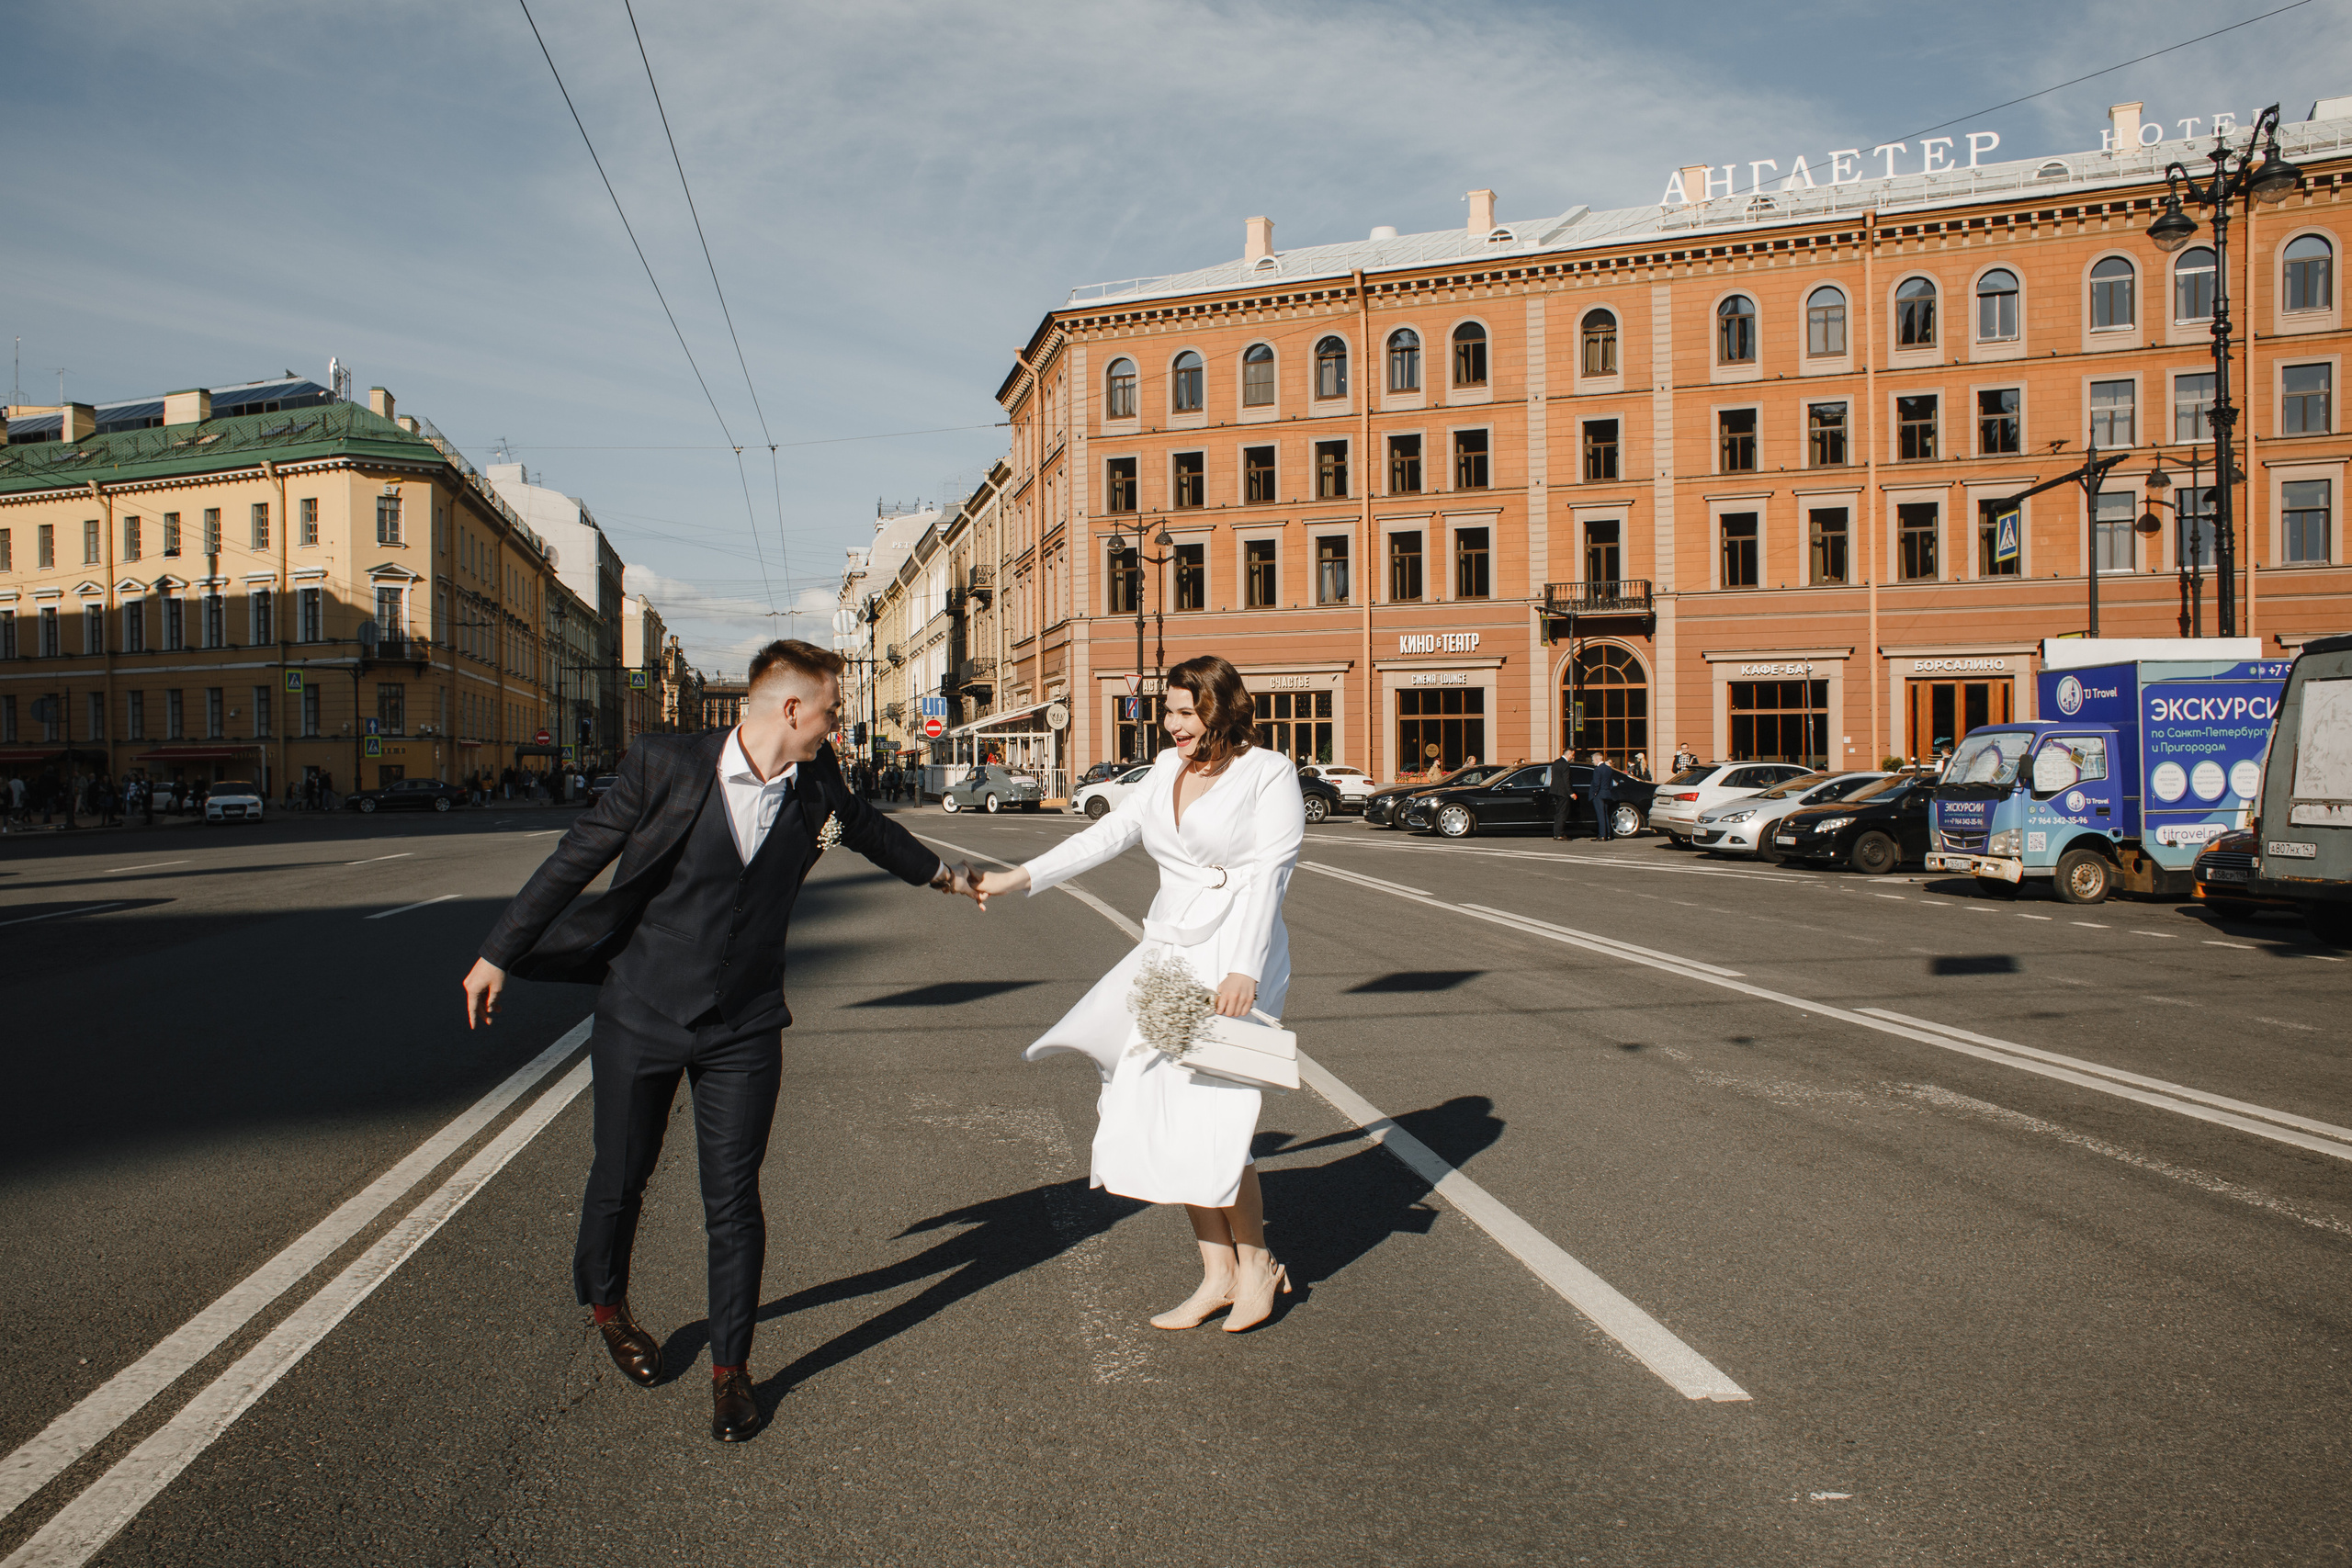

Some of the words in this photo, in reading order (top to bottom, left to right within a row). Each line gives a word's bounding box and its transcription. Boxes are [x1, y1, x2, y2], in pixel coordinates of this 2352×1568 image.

[1659, 131, 2000, 206] АНГЛЕТЕР
[383, 483, 400, 495] EY
[892, 541, 919, 550] PET
[1914, 659, 2005, 671] БОРСАЛИНО
[2267, 664, 2282, 676] +7
[1270, 676, 1310, 688] СЧАСТЬЕ
[1411, 674, 1436, 685] CINEMA
[1440, 673, 1466, 684] LOUNGE
[2092, 686, 2118, 698] Travel
[2160, 742, 2226, 754] Пригородам
[1944, 803, 1984, 812] ЭКСКУРСИИ
[2028, 817, 2037, 825] +7
[2038, 817, 2052, 825] 964
[2052, 817, 2088, 825] 342-35-96
